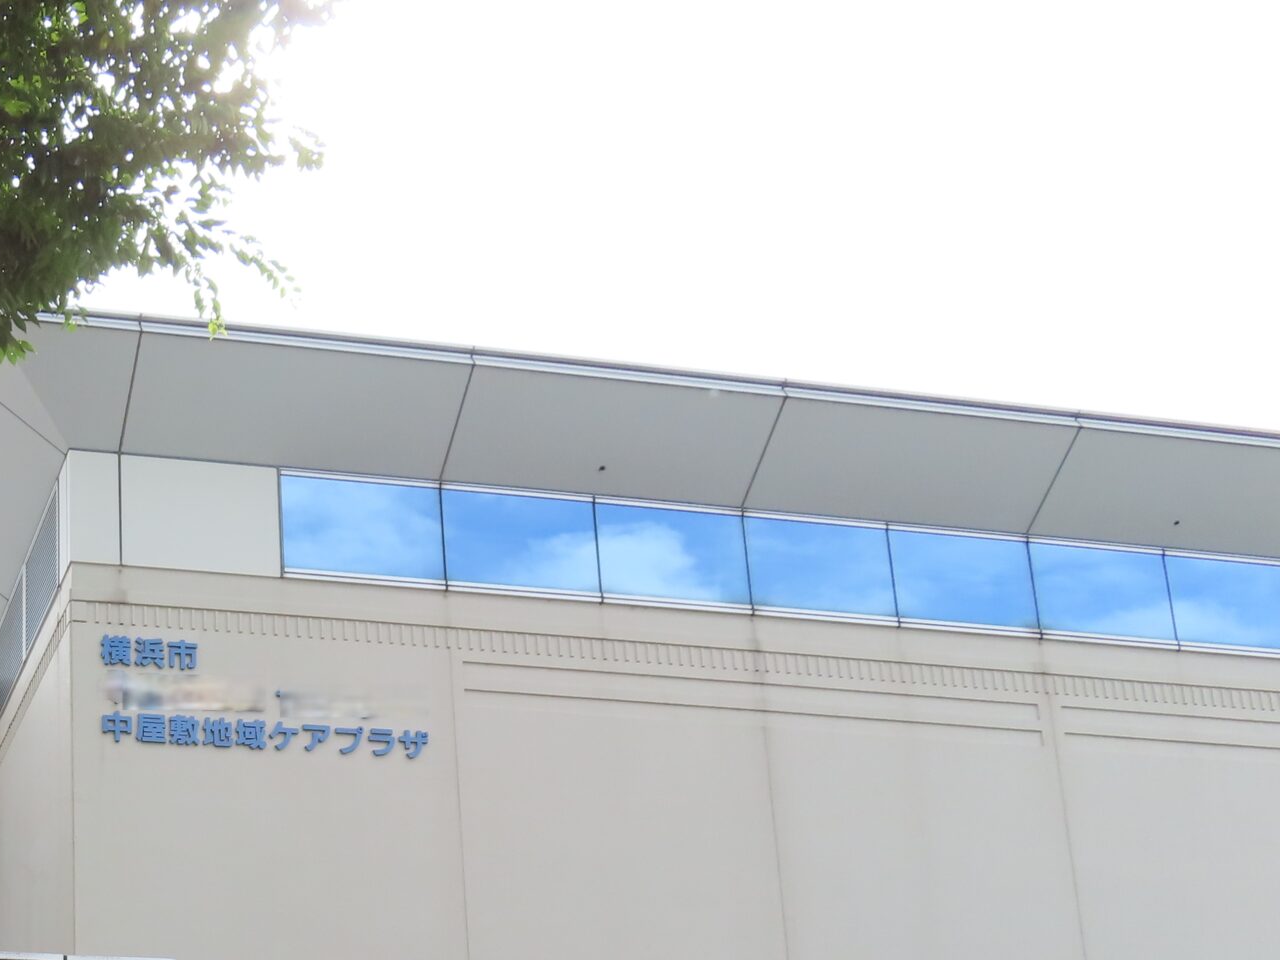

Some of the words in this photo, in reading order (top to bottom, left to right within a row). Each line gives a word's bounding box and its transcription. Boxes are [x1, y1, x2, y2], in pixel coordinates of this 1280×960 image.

[100, 634, 198, 670] 横浜市
[101, 711, 429, 759] 中屋敷地域ケアプラザ
